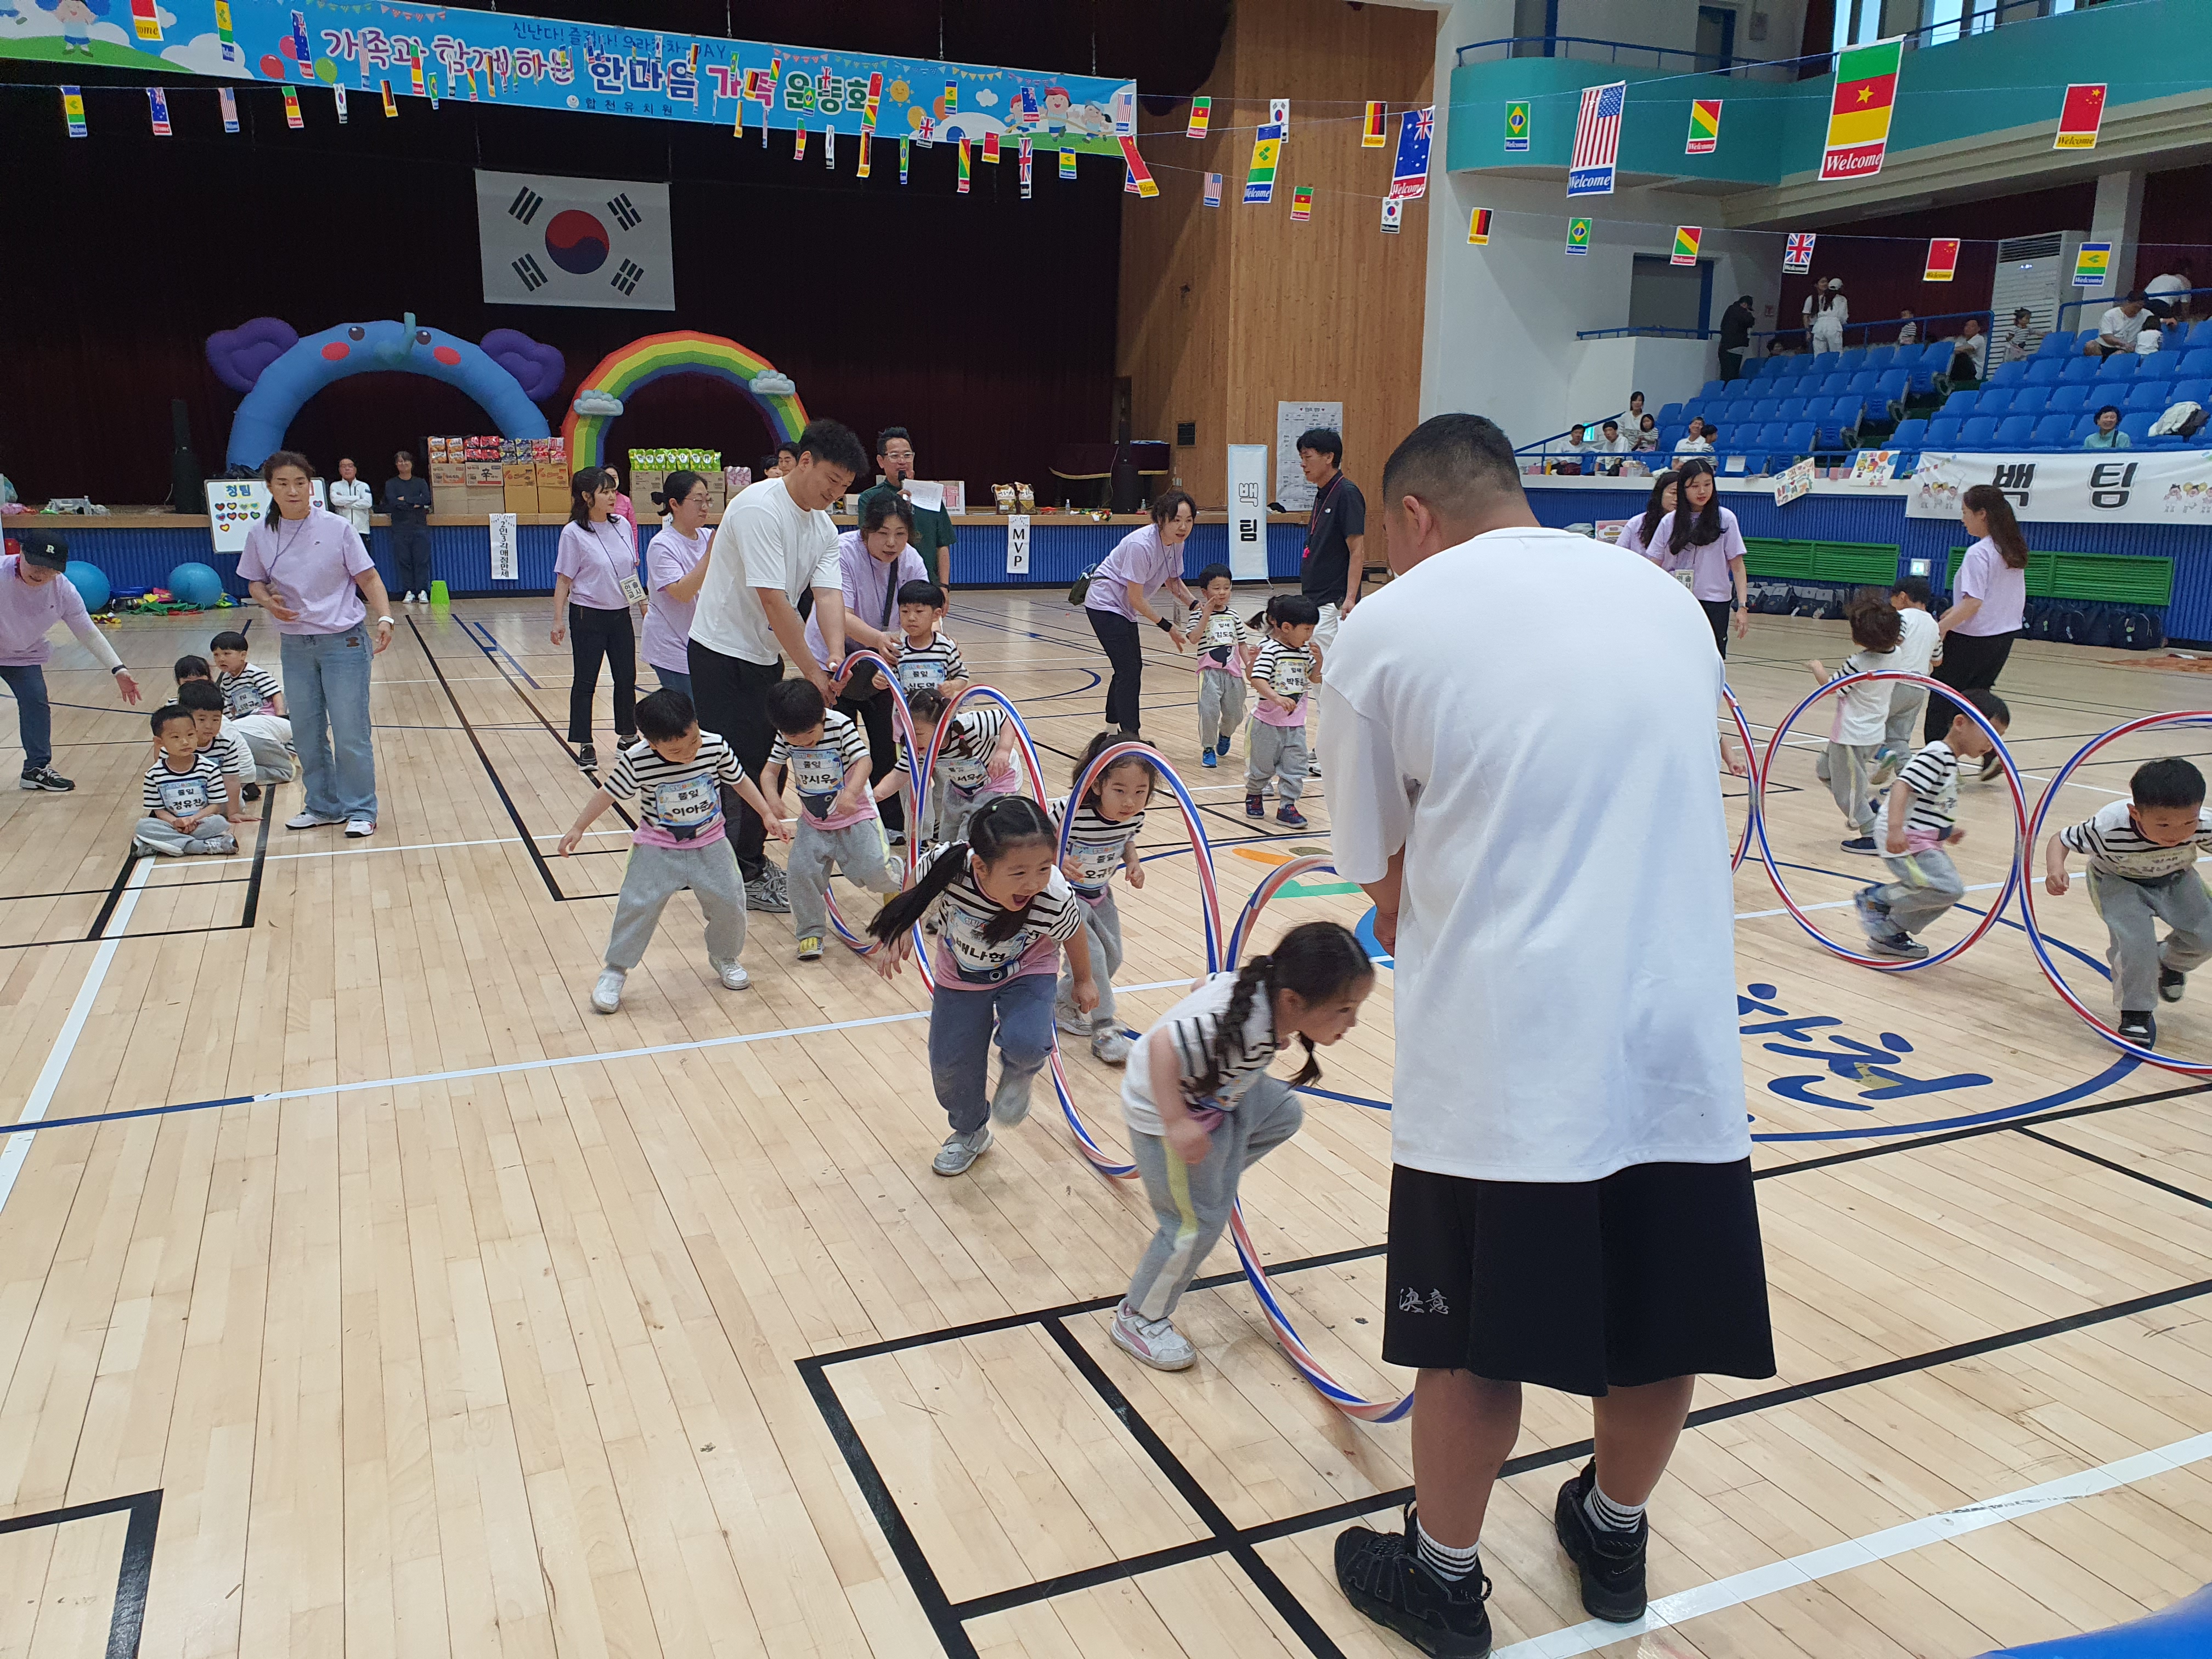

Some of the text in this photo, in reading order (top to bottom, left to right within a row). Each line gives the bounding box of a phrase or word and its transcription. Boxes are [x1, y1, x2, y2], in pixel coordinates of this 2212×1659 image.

[513, 22, 563, 41] 신난다!
[324, 30, 427, 67] 가족과
[590, 52, 696, 99] 한마음
[708, 67, 772, 106] 가족
[2058, 137, 2095, 145] Welcome
[1826, 152, 1881, 172] Welcome
[1391, 182, 1425, 196] Welcome
[1569, 174, 1611, 189] Welcome
[1245, 188, 1270, 199] Welcome
[481, 467, 493, 482] 辛
[46, 544, 55, 554] R
[1013, 528, 1025, 567] MVP
[804, 760, 821, 769] 풀잎
[799, 774, 832, 785] 강시우
[678, 789, 699, 800] 풀잎
[672, 799, 709, 816] 이아준
[956, 936, 1006, 963] 배나현
